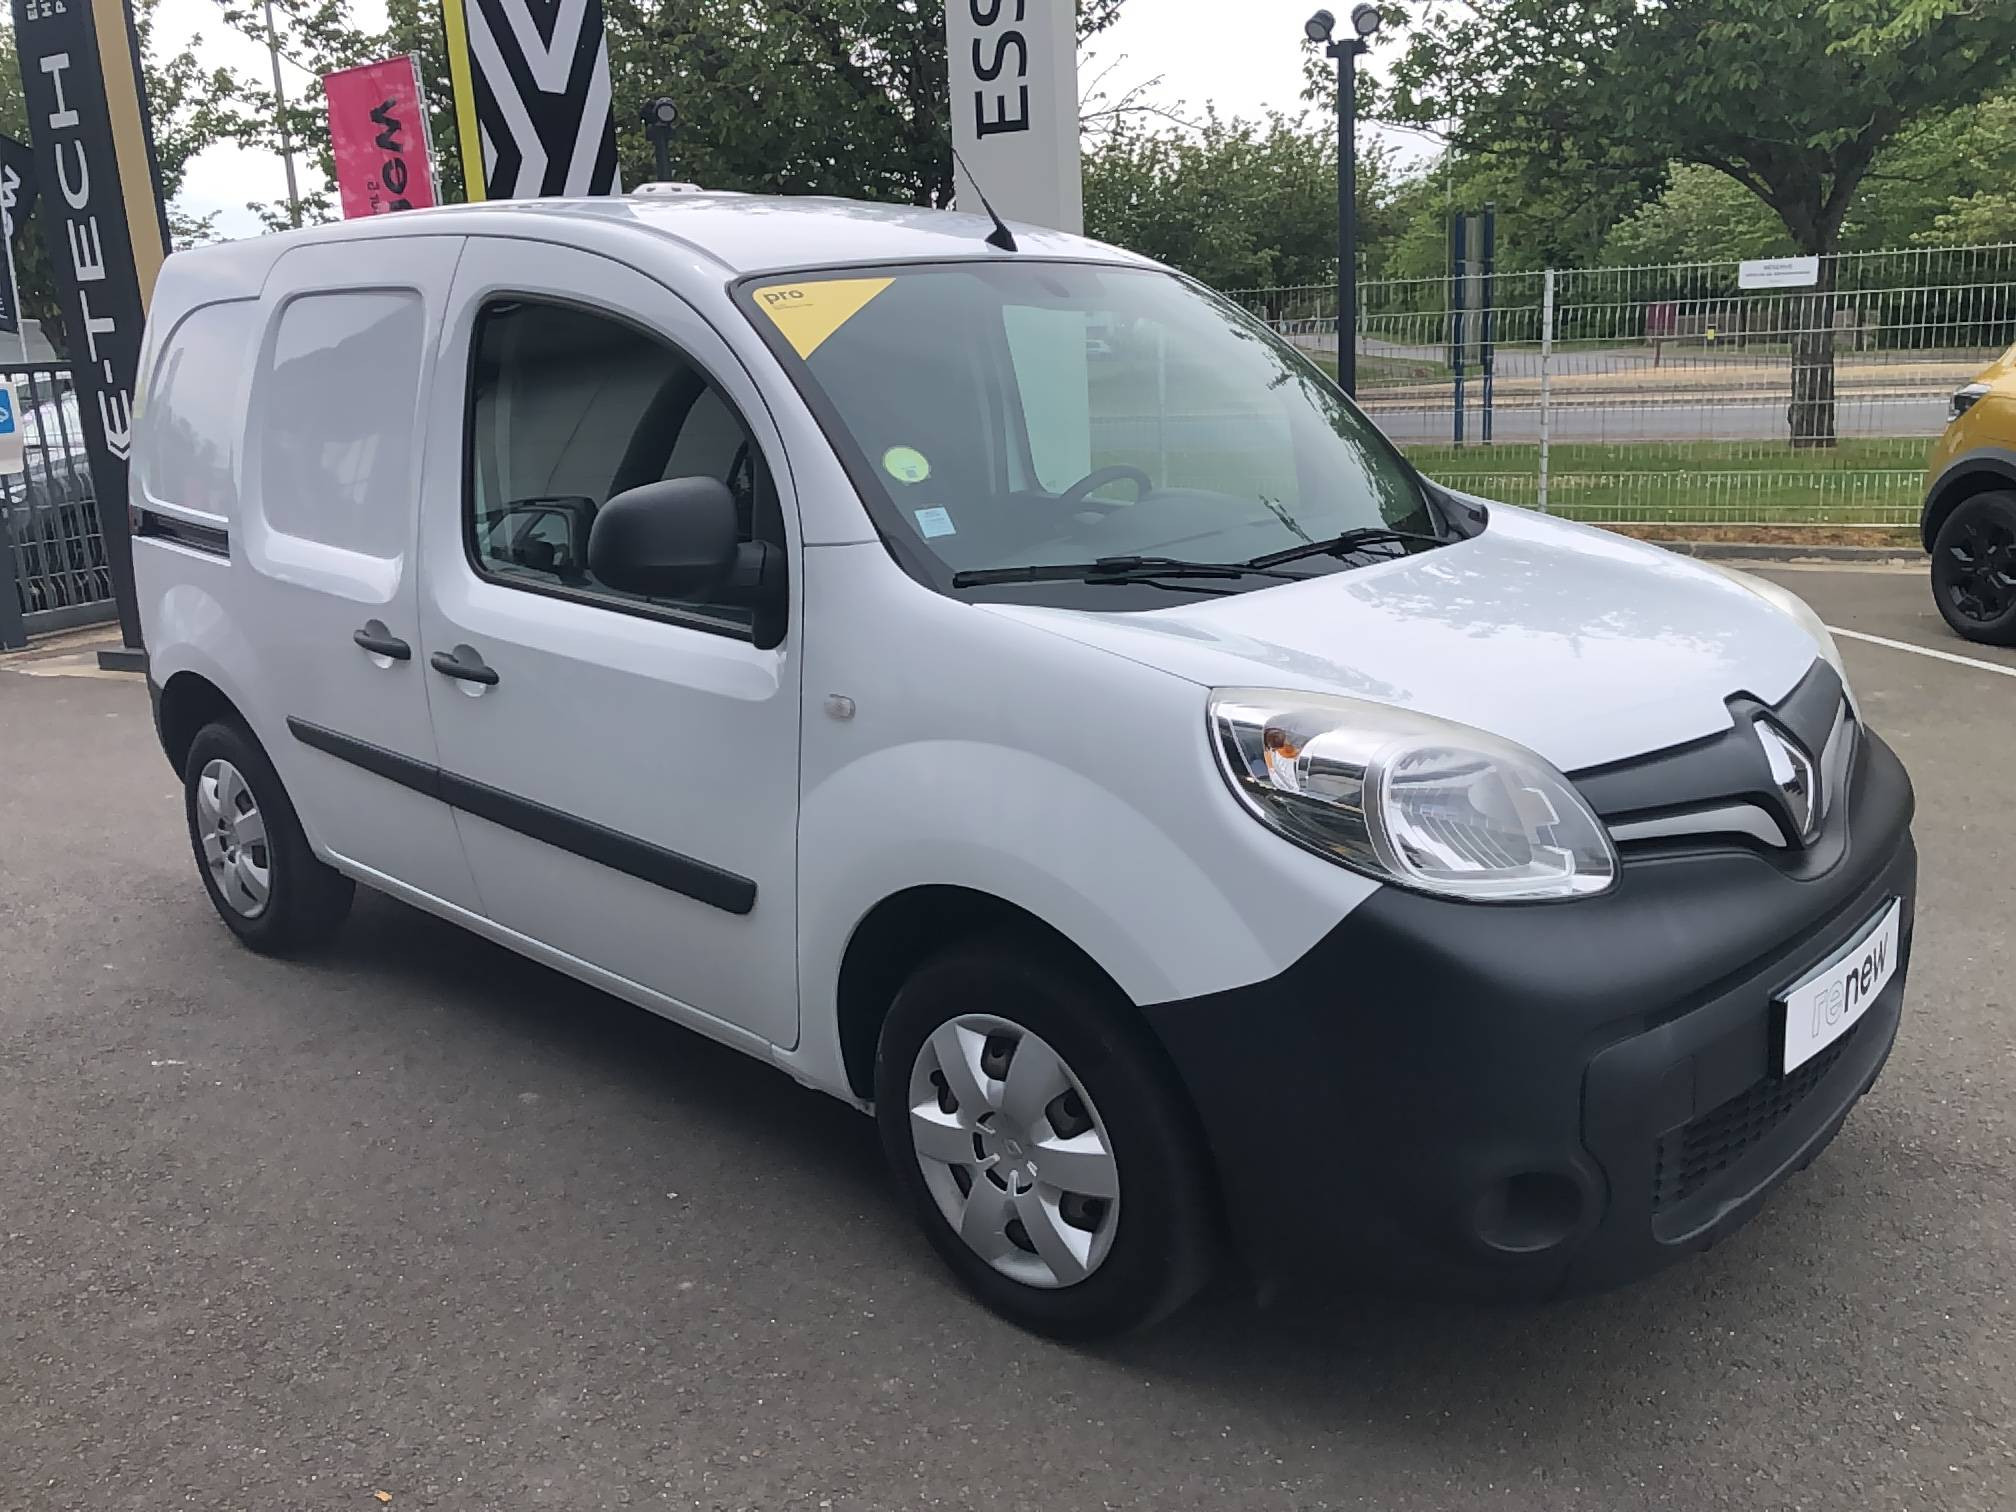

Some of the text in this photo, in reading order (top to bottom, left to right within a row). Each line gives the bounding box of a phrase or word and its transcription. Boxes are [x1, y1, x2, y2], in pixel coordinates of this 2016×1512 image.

[39, 53, 131, 460] E-TECH
[763, 289, 804, 304] pro
[1812, 932, 1889, 1038] renew
